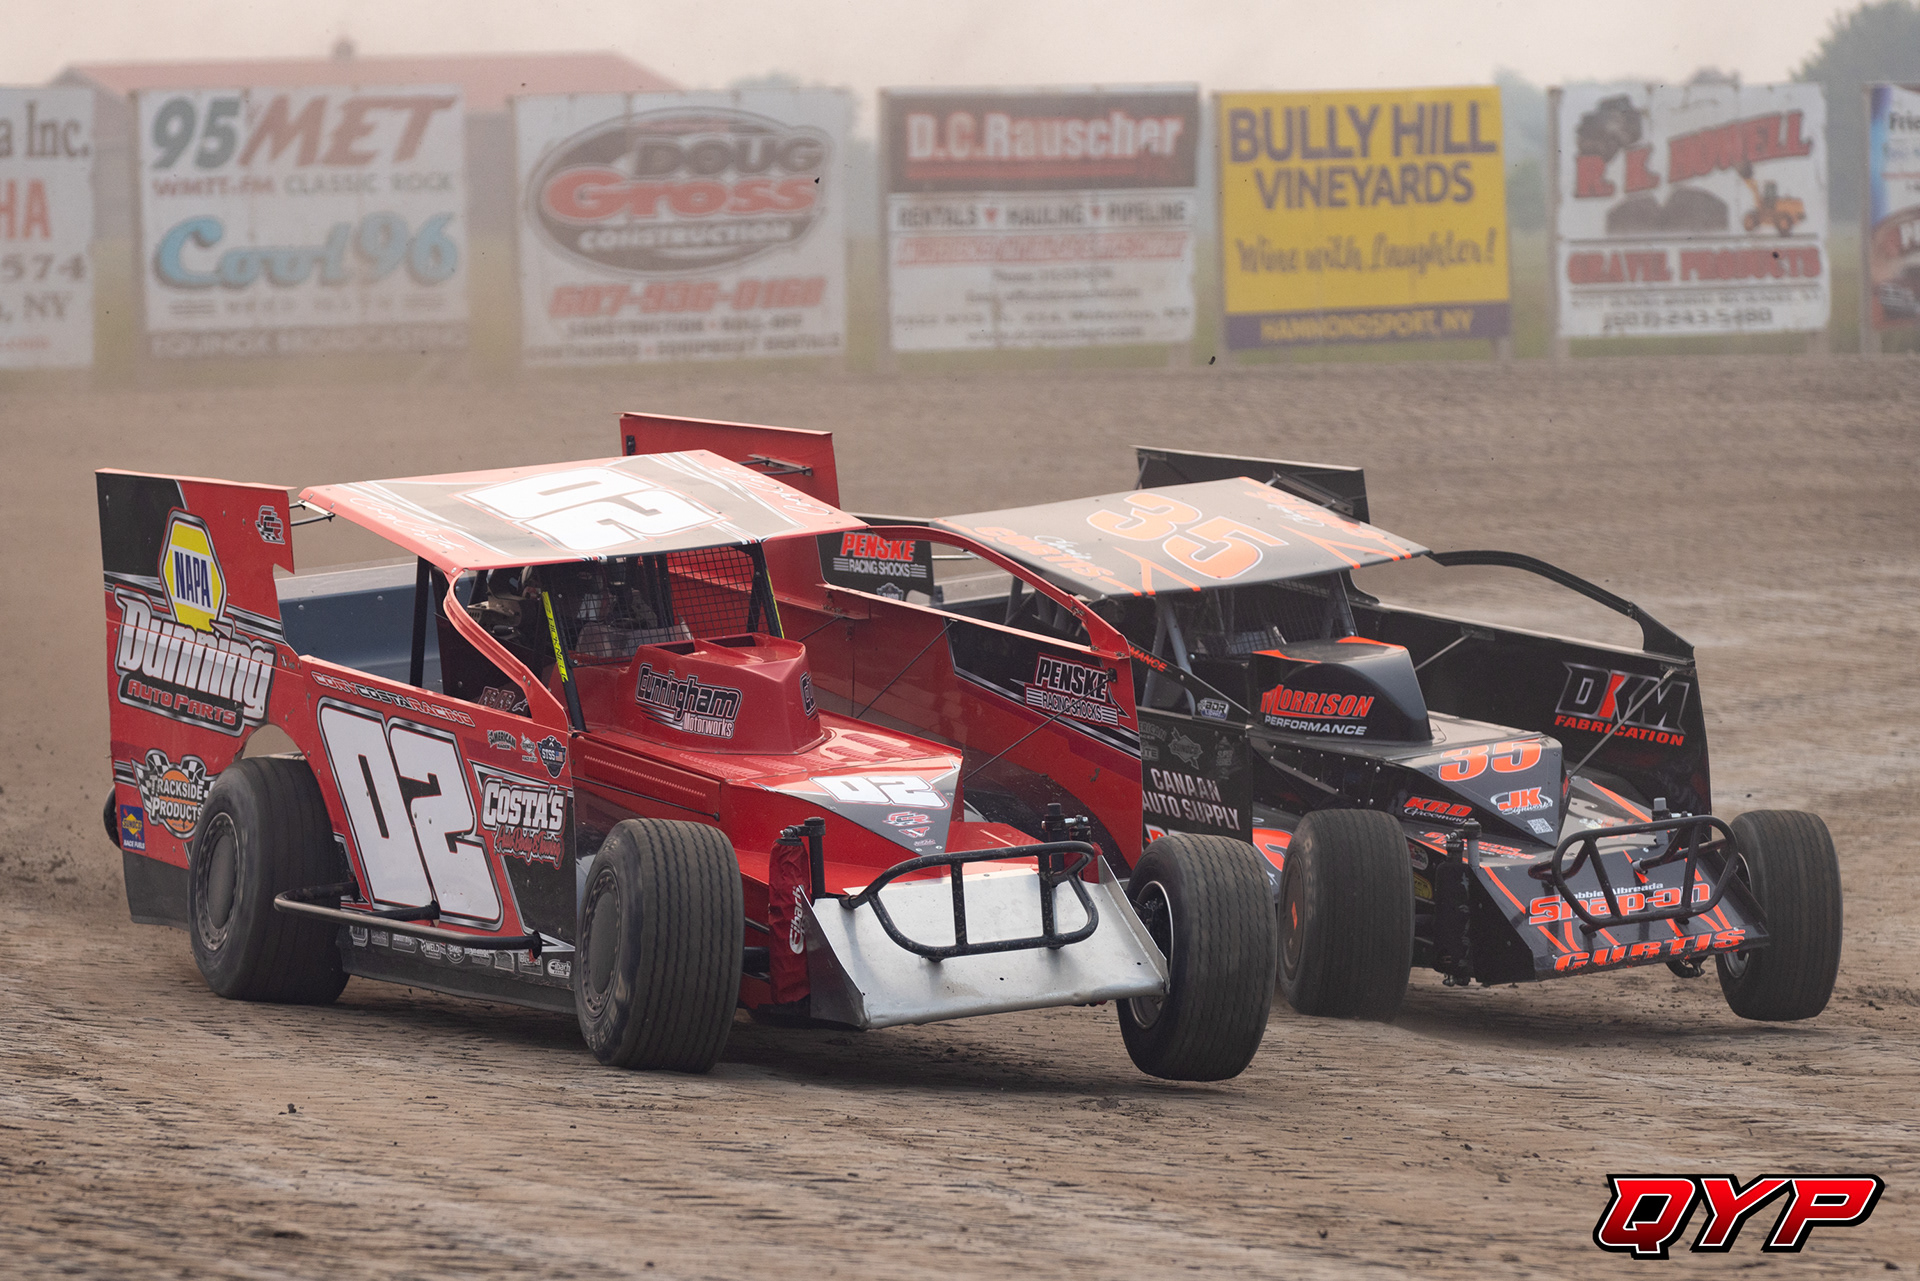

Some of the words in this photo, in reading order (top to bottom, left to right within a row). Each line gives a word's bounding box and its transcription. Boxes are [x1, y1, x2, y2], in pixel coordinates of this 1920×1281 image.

[25, 100, 90, 159] Inc.
[1228, 104, 1381, 163] BULLY
[1392, 101, 1497, 157] HILL
[635, 138, 824, 176] DOUG
[1254, 160, 1476, 210] VINEYARDS
[579, 221, 791, 249] CONSTRUCTION
[1305, 234, 1362, 272] with
[1679, 246, 1822, 282] PRODUCTS
[841, 532, 915, 561] PENSKE
[1087, 492, 1289, 579] 35
[174, 551, 211, 608] NAPA
[849, 558, 878, 575] RACING
[878, 561, 911, 578] SHOCKS
[1036, 657, 1108, 701] PENSKE
[1041, 690, 1071, 713] RACING
[1070, 697, 1102, 722] SHOCKS
[1260, 684, 1374, 718] MORRISON
[1555, 662, 1690, 734] DKM
[683, 713, 734, 737] Motorworks
[1264, 714, 1367, 736] PERFORMANCE
[1555, 715, 1685, 746] FABRICATION
[1438, 739, 1542, 781] 35
[150, 774, 204, 799] TRACKSIDE
[811, 776, 948, 808] 02
[1150, 768, 1221, 802] CANAAN
[1498, 787, 1542, 810] JK
[320, 706, 500, 921] 02
[483, 782, 564, 830] COSTA'S
[1142, 790, 1181, 818] AUTO
[1181, 798, 1241, 831] SUPPLY
[1403, 797, 1473, 817] KRD
[1404, 807, 1468, 824] Grooming
[1529, 884, 1711, 925] Snap-on
[1555, 929, 1746, 972] CURTIS
